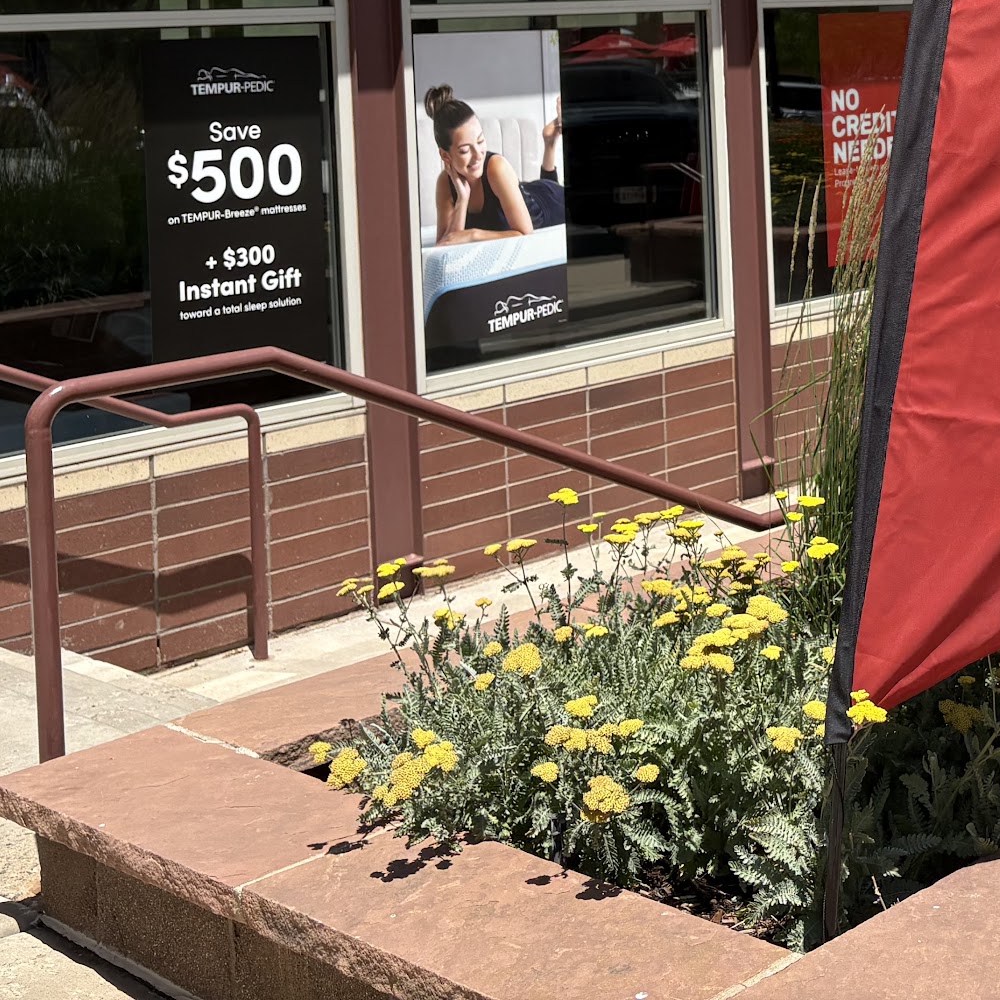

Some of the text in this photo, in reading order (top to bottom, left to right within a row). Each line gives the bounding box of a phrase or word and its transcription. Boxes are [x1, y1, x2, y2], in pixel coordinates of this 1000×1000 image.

[831, 88, 860, 112] NO
[209, 121, 262, 142] Save
[832, 110, 897, 138] CREDI
[167, 143, 302, 203] $500
[167, 215, 180, 225] on
[260, 203, 307, 216] mattresses
[222, 244, 275, 270] $300
[179, 267, 302, 302] Instant Gift
[179, 296, 302, 320] toward a total sleep solution
